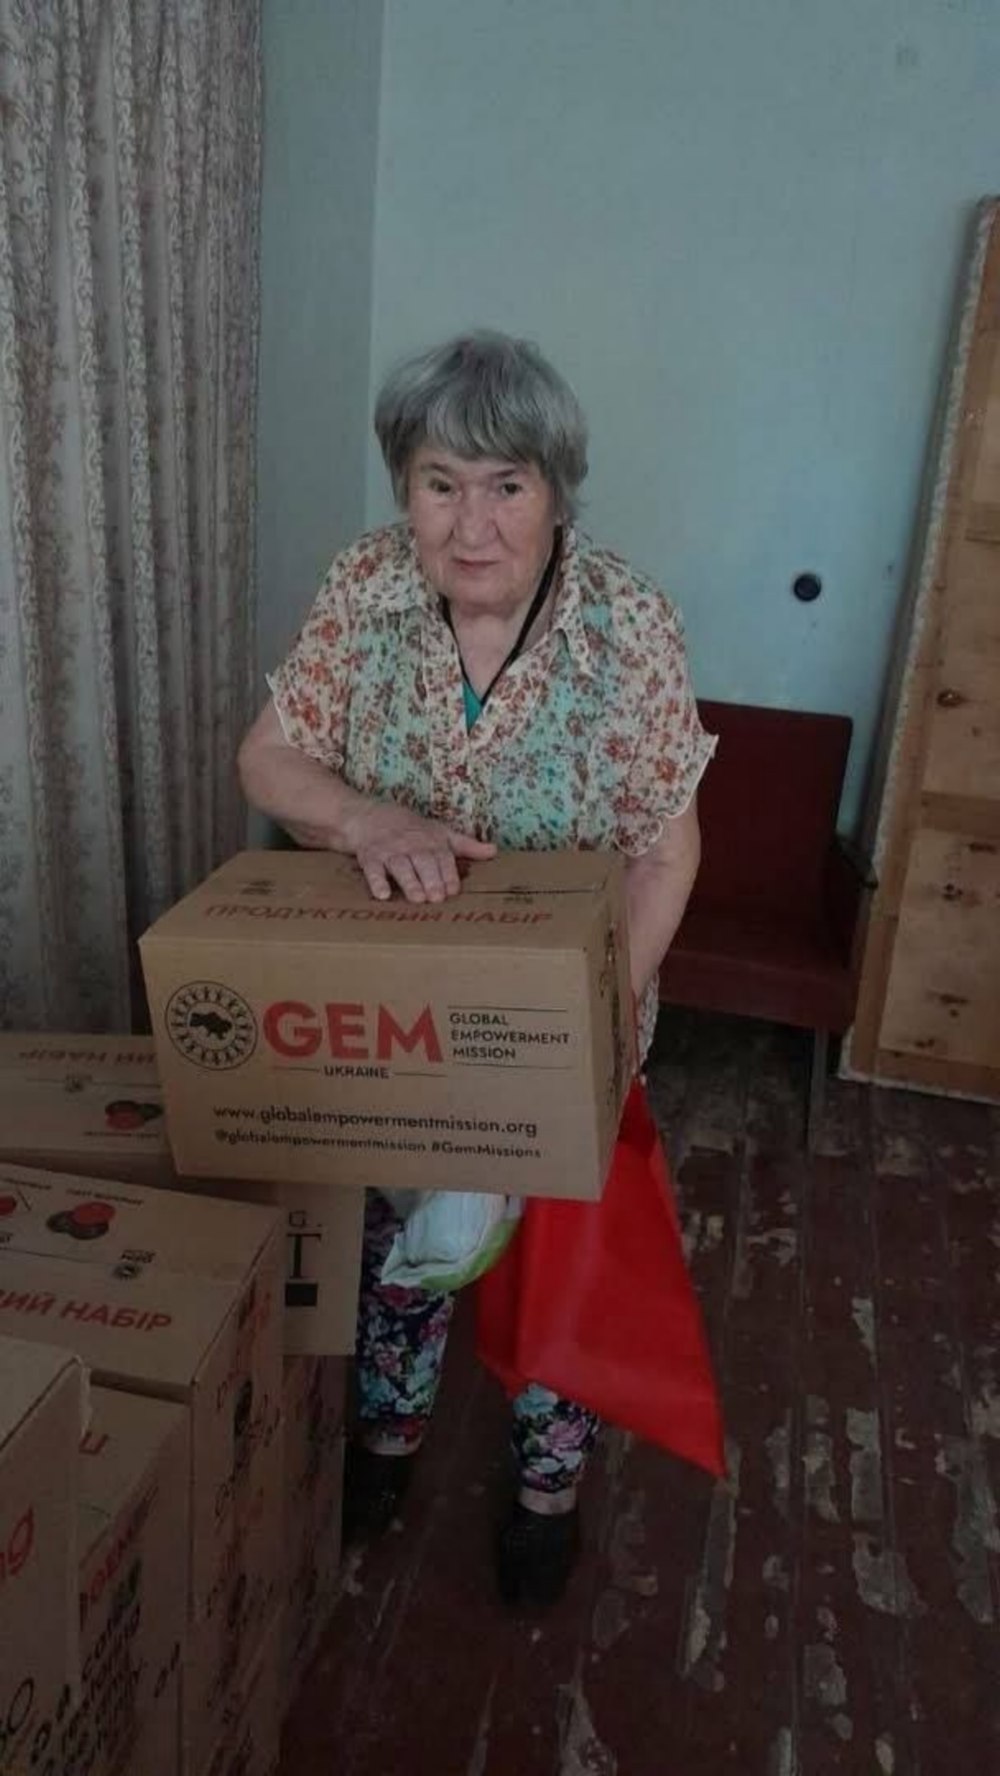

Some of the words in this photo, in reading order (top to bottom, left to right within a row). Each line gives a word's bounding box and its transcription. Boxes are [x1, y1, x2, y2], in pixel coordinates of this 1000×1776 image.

[450, 1012, 509, 1026] GLOBAL
[263, 1000, 443, 1063] GEM
[451, 1029, 569, 1045] EMPOWERMENT
[453, 1046, 516, 1060] MISSION
[324, 1064, 390, 1080] UKRAINE
[213, 1105, 538, 1138] www.globalempowermentmission.org
[60, 1301, 172, 1332] НАБІР
